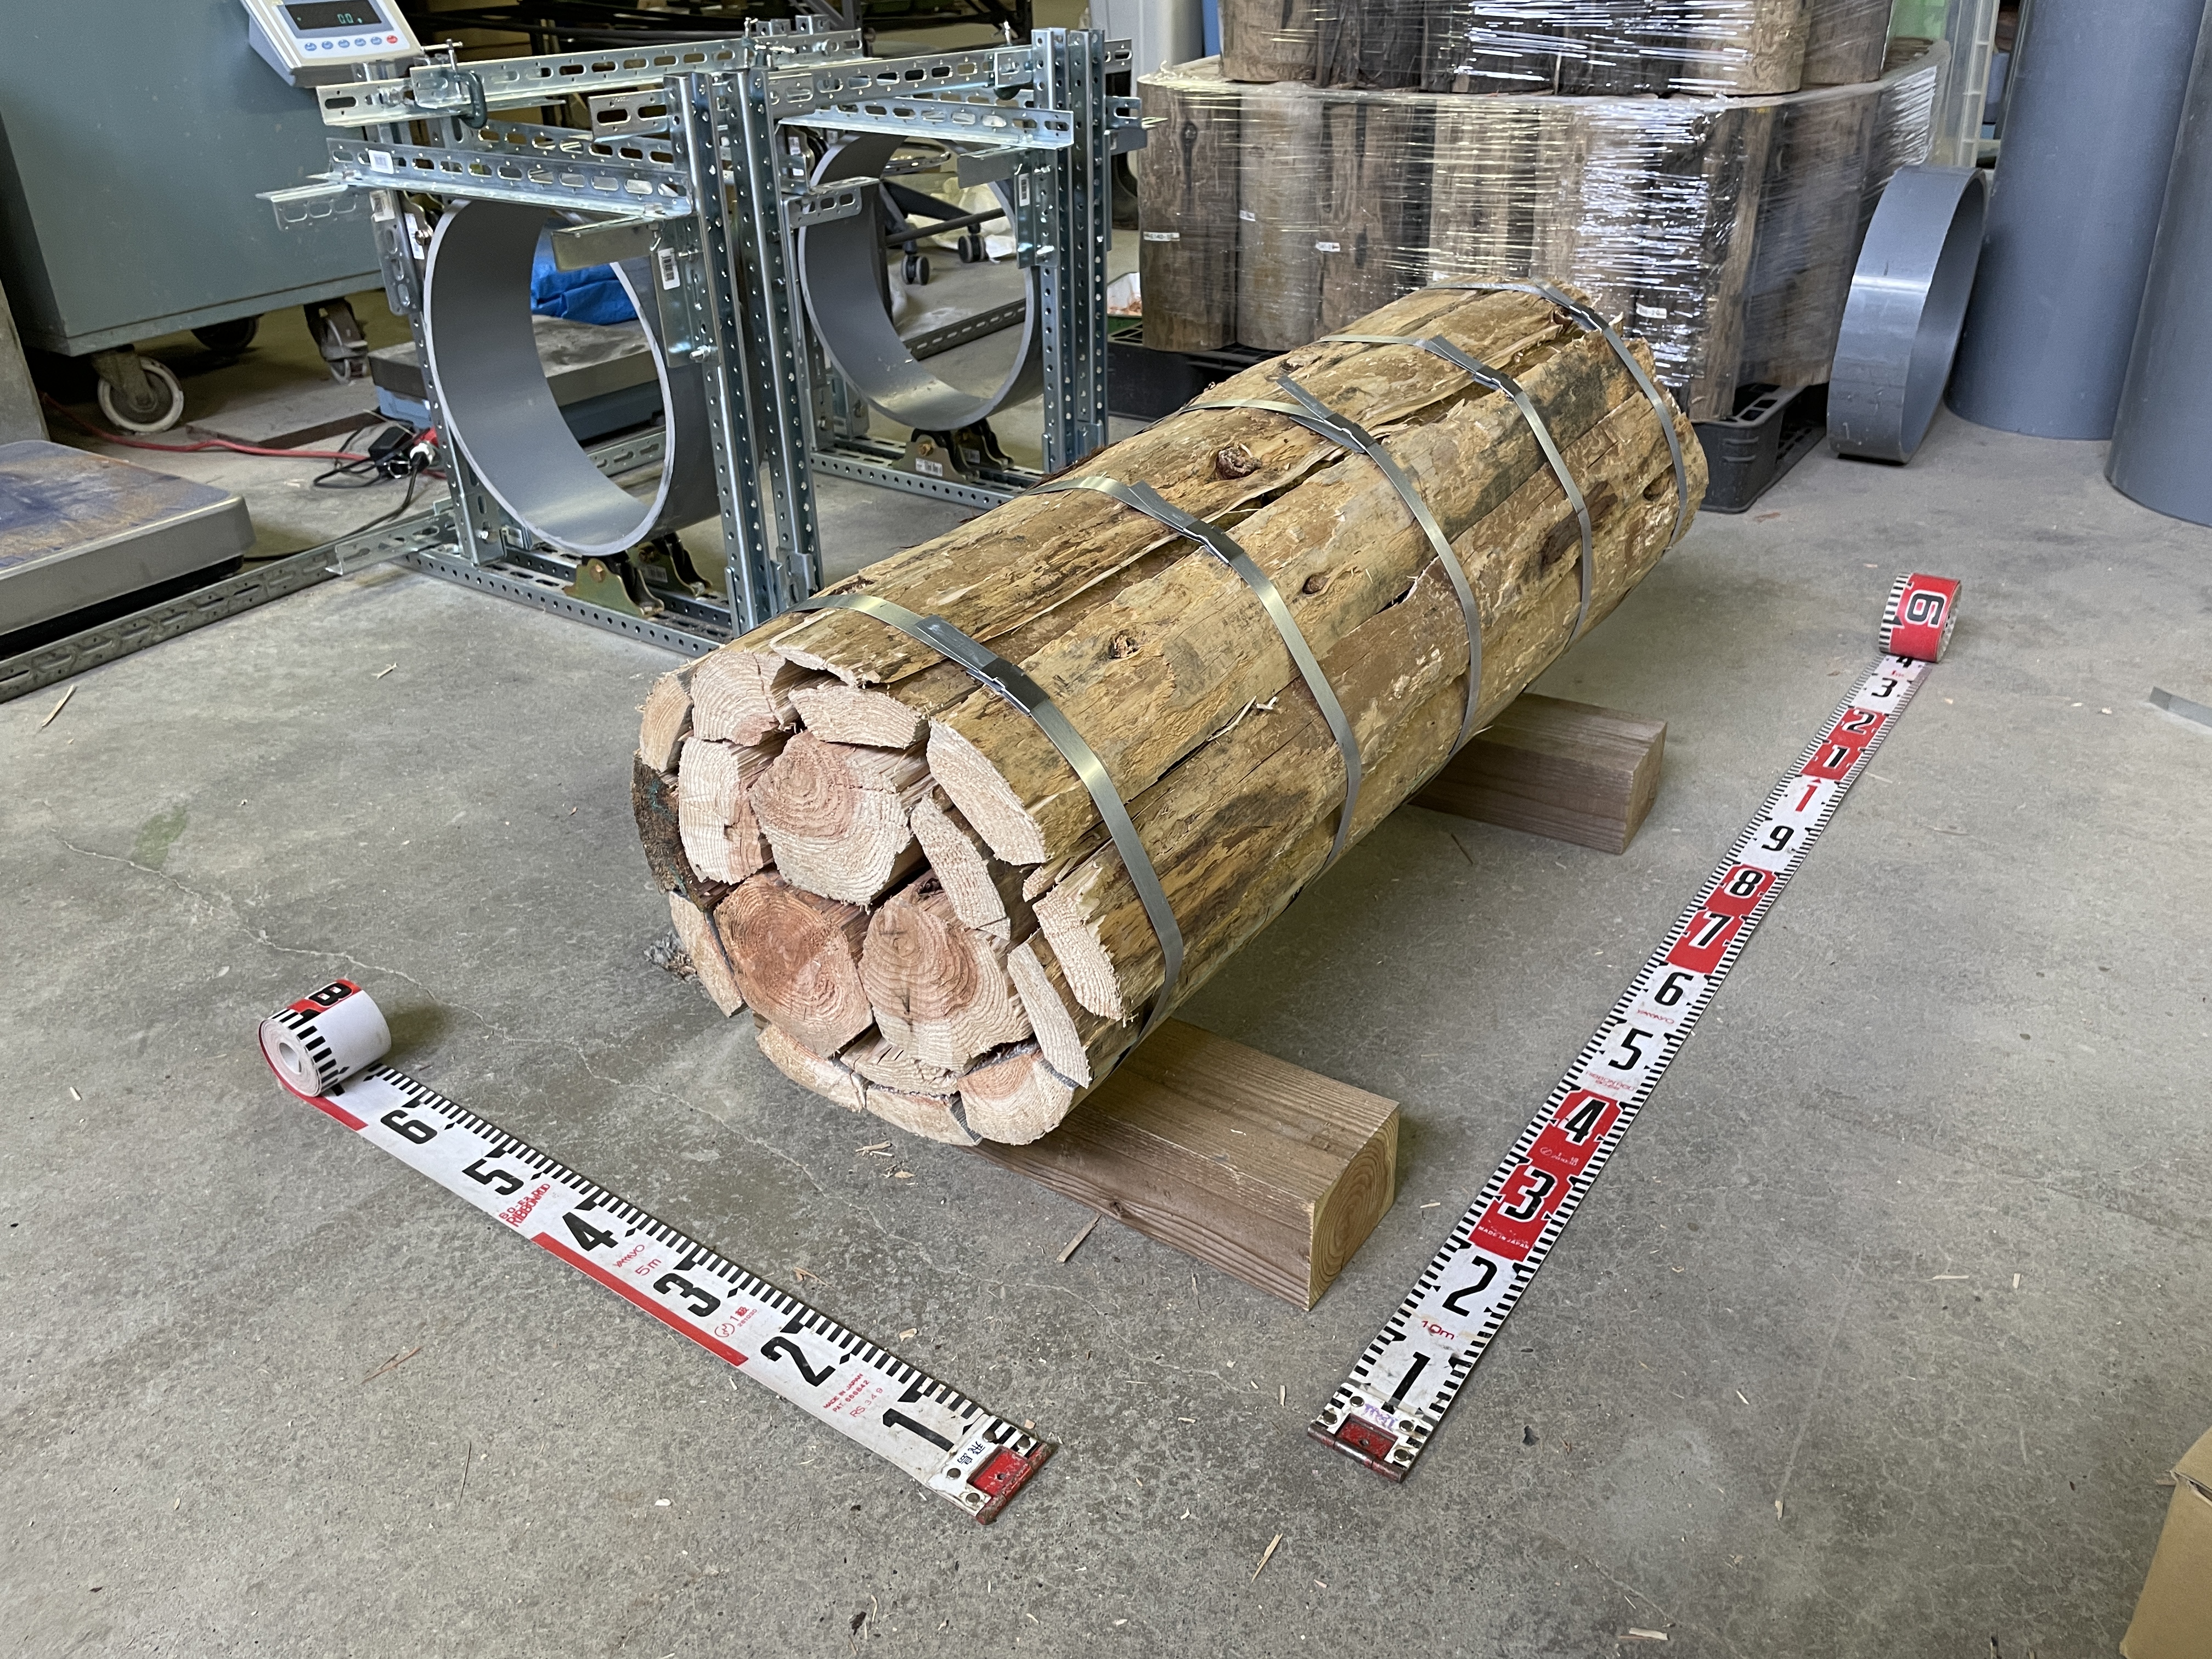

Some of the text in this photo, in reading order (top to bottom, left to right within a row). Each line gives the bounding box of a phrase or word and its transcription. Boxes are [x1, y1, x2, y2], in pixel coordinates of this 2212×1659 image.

[1871, 678, 1898, 697] 3
[1844, 711, 1876, 733] 2
[1826, 746, 1849, 768] 1
[1795, 785, 1818, 812] 1
[1761, 826, 1795, 851] 9
[1729, 870, 1763, 896] 8
[1696, 913, 1733, 947] 7
[309, 983, 352, 1006] 8
[1654, 972, 1694, 1006] 6
[1608, 1028, 1654, 1070] 5
[381, 1110, 437, 1144] 6
[1564, 1098, 1607, 1143] 4
[462, 1159, 524, 1195] 5
[1503, 1169, 1556, 1221] 3
[562, 1212, 618, 1251] 4
[635, 1259, 662, 1276] 5m
[653, 1273, 720, 1317] 3
[1442, 1255, 1497, 1317] 2
[1422, 1321, 1454, 1340] 10m
[760, 1336, 836, 1386] 2
[823, 1396, 839, 1408] MADE
[846, 1373, 863, 1391] JAPAN
[1383, 1352, 1430, 1413] 1
[850, 1406, 865, 1418] RS
[883, 1408, 954, 1451] 1
